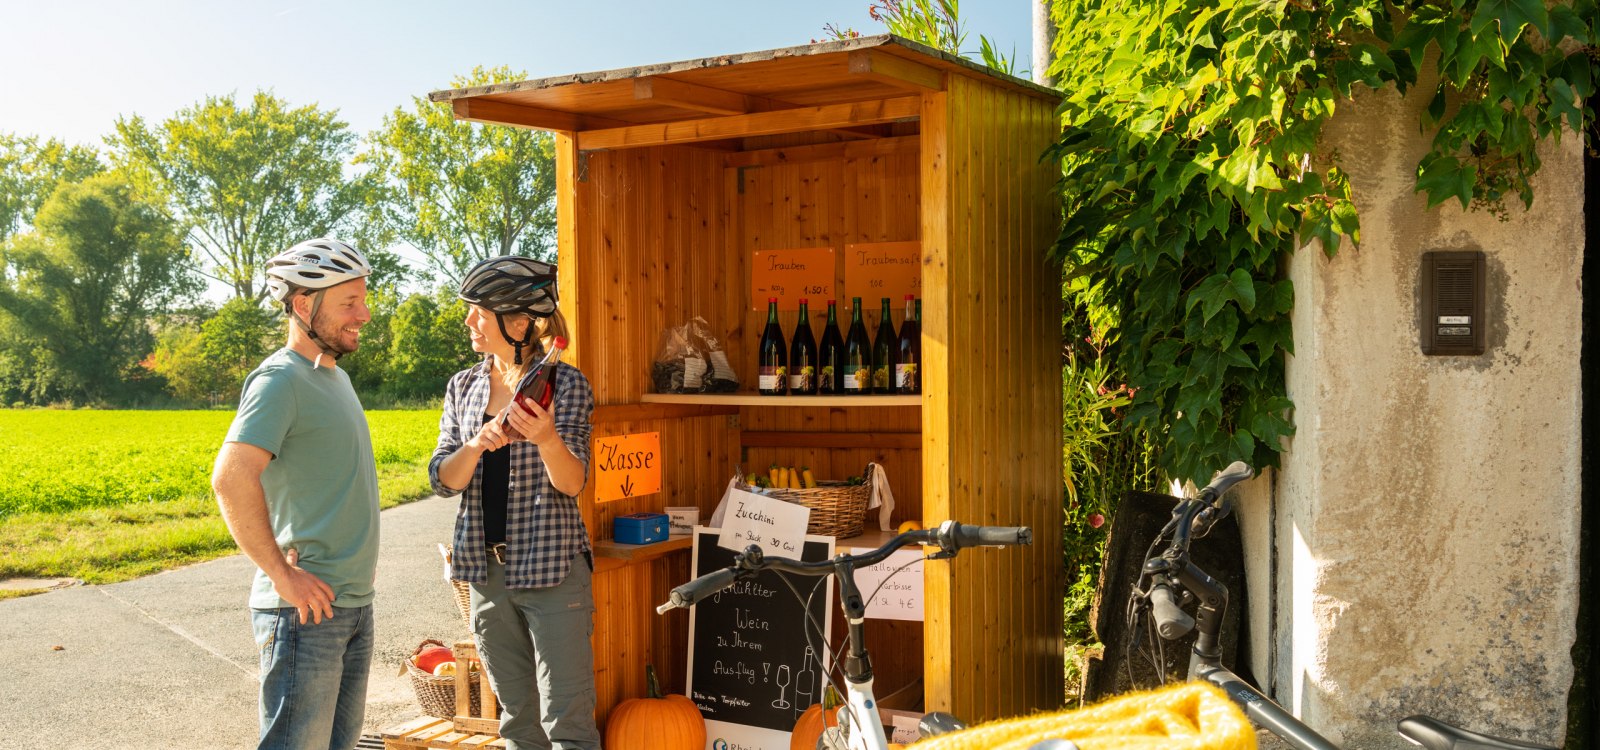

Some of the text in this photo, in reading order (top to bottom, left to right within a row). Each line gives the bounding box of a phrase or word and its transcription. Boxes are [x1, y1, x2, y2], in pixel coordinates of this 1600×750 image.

[768, 255, 806, 271] Trauben
[599, 443, 653, 471] Kasse
[735, 501, 775, 525] Zucchini
[770, 537, 781, 548] 30
[735, 608, 769, 630] Wein
[731, 631, 762, 651] Ihrem
